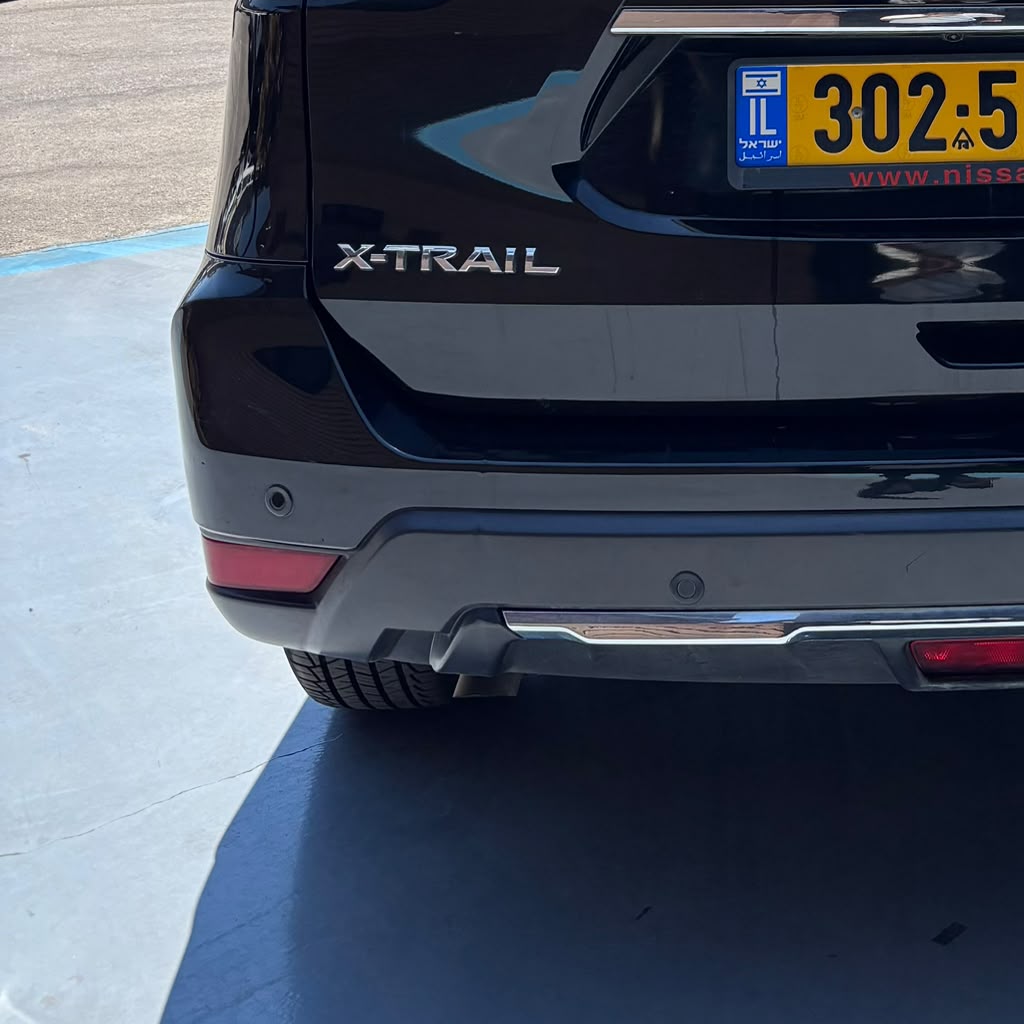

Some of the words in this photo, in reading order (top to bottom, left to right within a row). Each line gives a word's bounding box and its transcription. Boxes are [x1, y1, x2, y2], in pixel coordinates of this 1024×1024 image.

[749, 97, 777, 136] IL
[738, 137, 783, 150] ישראל
[333, 242, 561, 274] X-TRAIL
